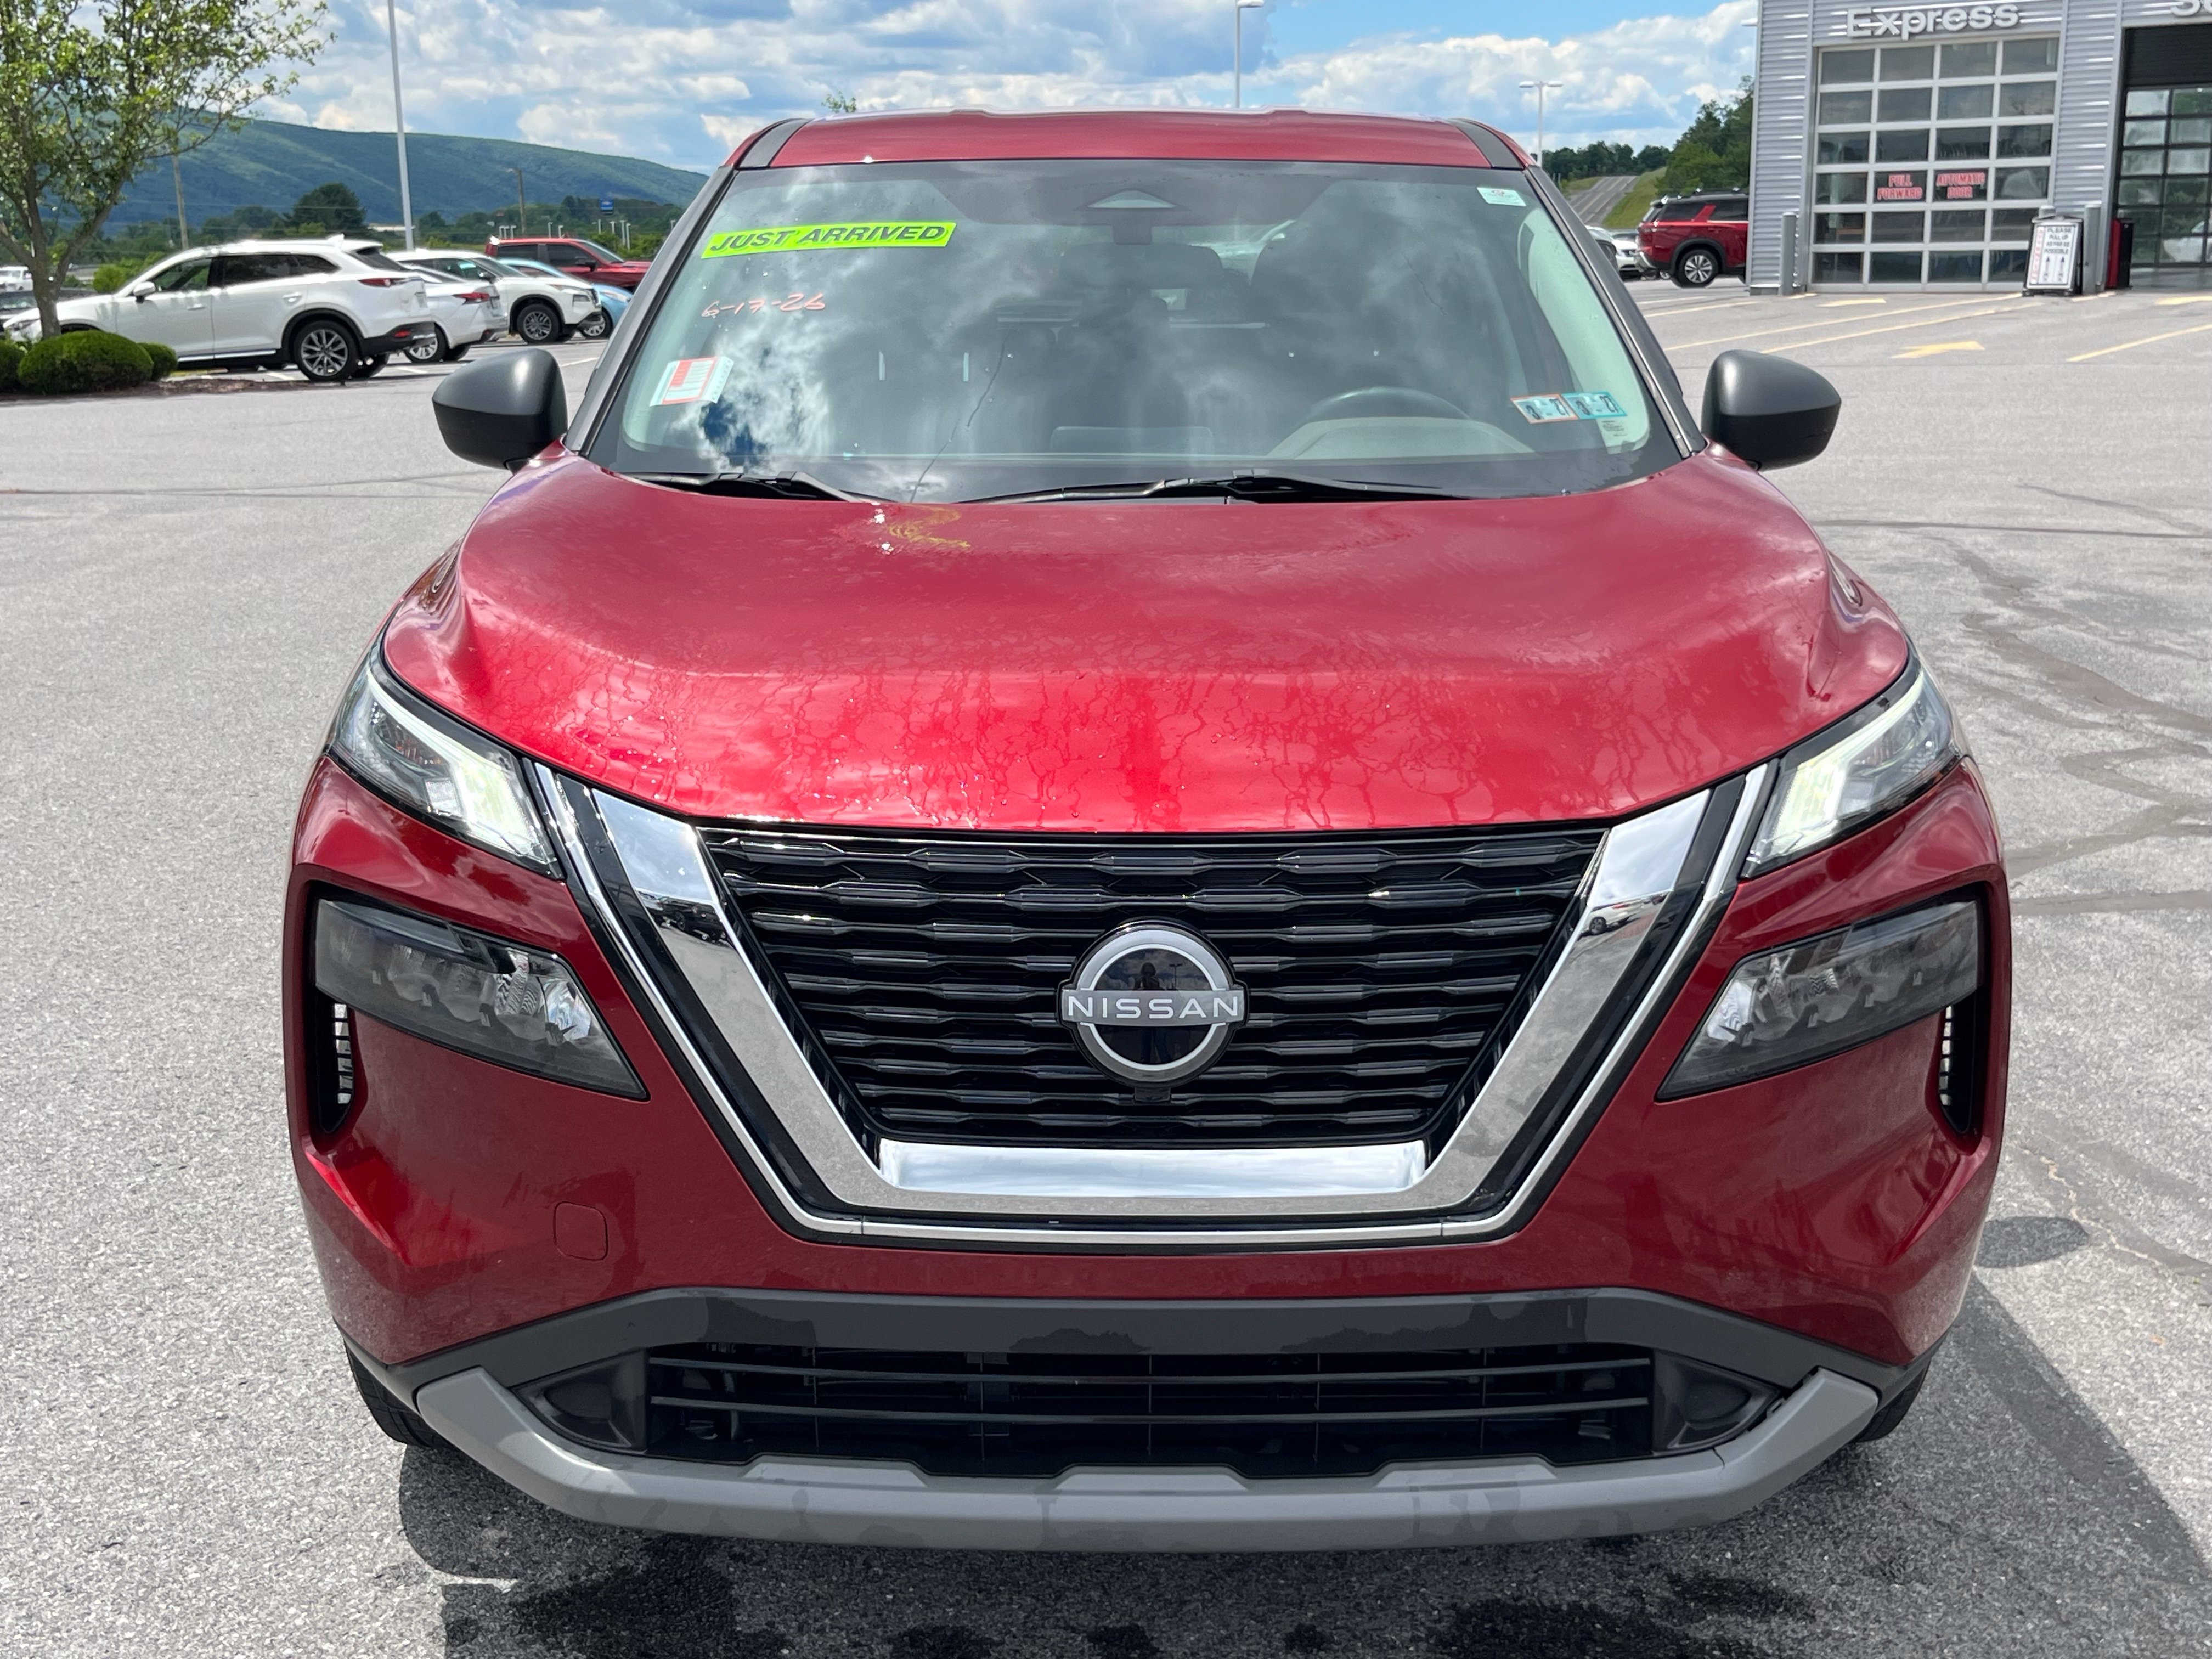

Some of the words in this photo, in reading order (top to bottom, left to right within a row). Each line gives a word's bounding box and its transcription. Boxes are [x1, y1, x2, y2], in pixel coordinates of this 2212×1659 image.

[1847, 4, 2019, 40] Express
[1936, 172, 1985, 187] AUTOMATIC
[1877, 187, 1922, 200] FORWARD
[1947, 185, 1973, 199] DOOR
[710, 230, 796, 251] JUST
[797, 225, 947, 244] ARRIVED
[1068, 996, 1238, 1019] NISSAN
